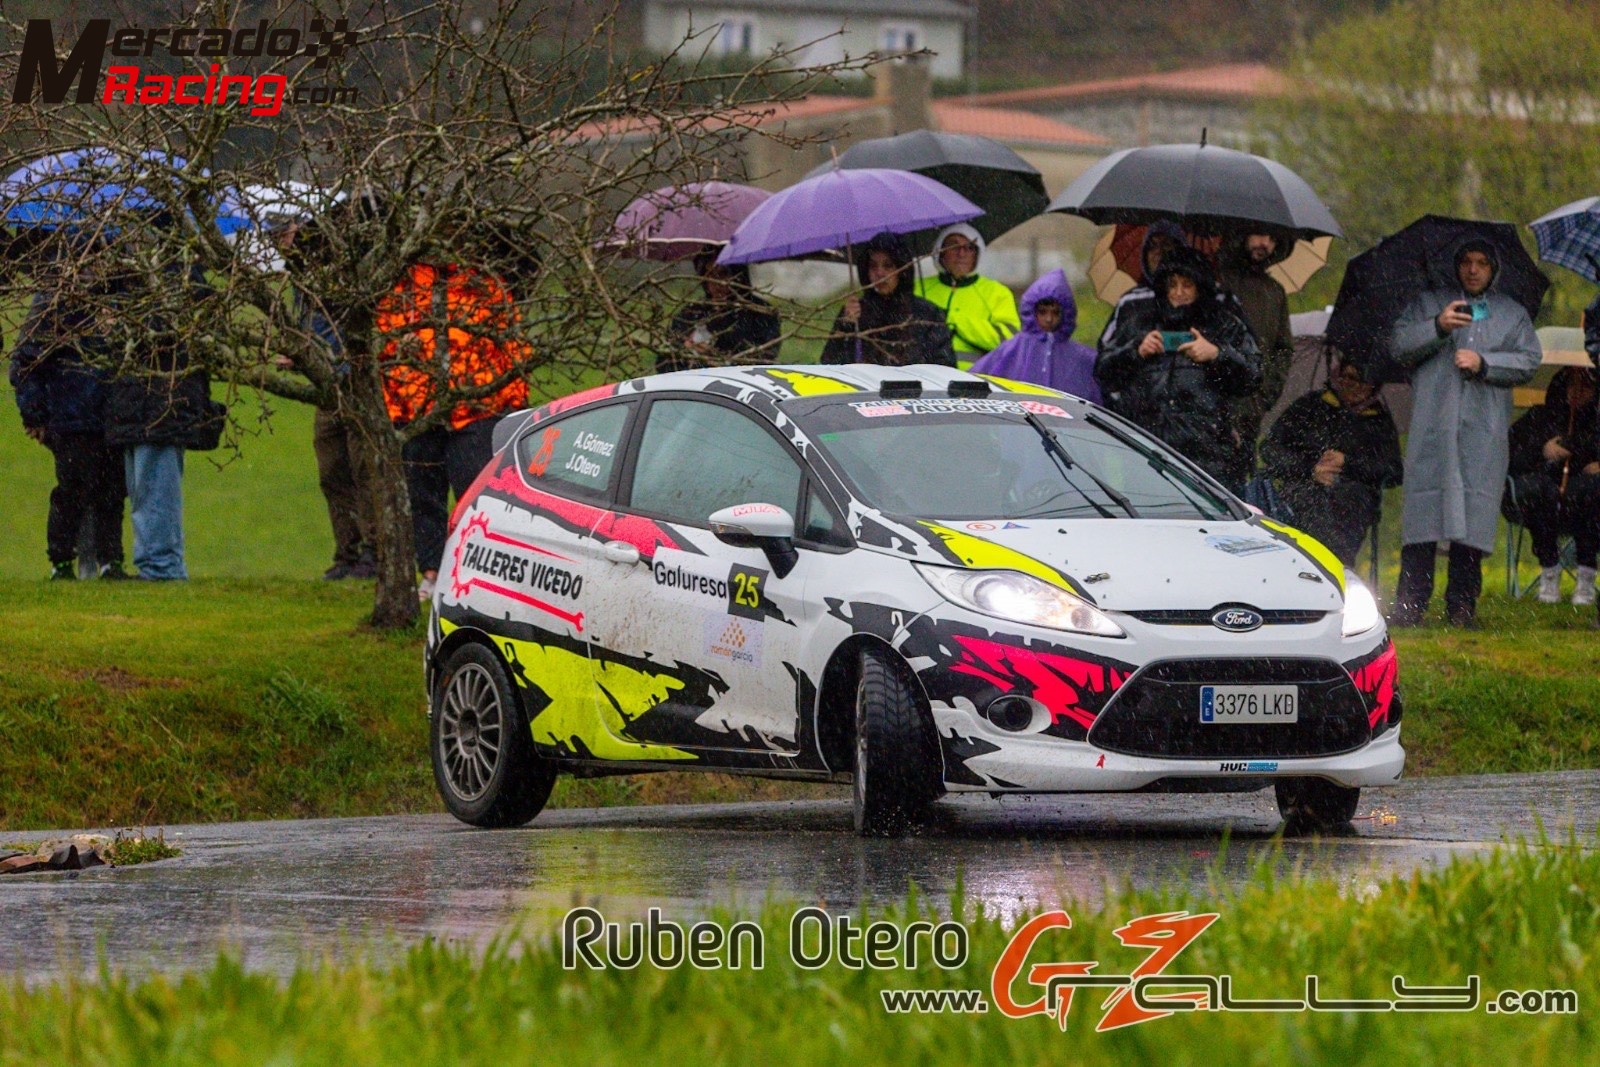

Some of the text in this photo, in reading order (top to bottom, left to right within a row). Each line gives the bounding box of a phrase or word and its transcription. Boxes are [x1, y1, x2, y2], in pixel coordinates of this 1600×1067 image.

[914, 403, 1029, 415] ADOLFO
[573, 431, 614, 456] A.Gómez
[565, 453, 600, 477] J.Otero
[462, 542, 583, 600] TALLERES VICEDO
[654, 561, 760, 608] Galuresa 25
[1226, 611, 1252, 625] Ford
[1205, 708, 1210, 716] E
[1215, 693, 1294, 716] 3376 LKD
